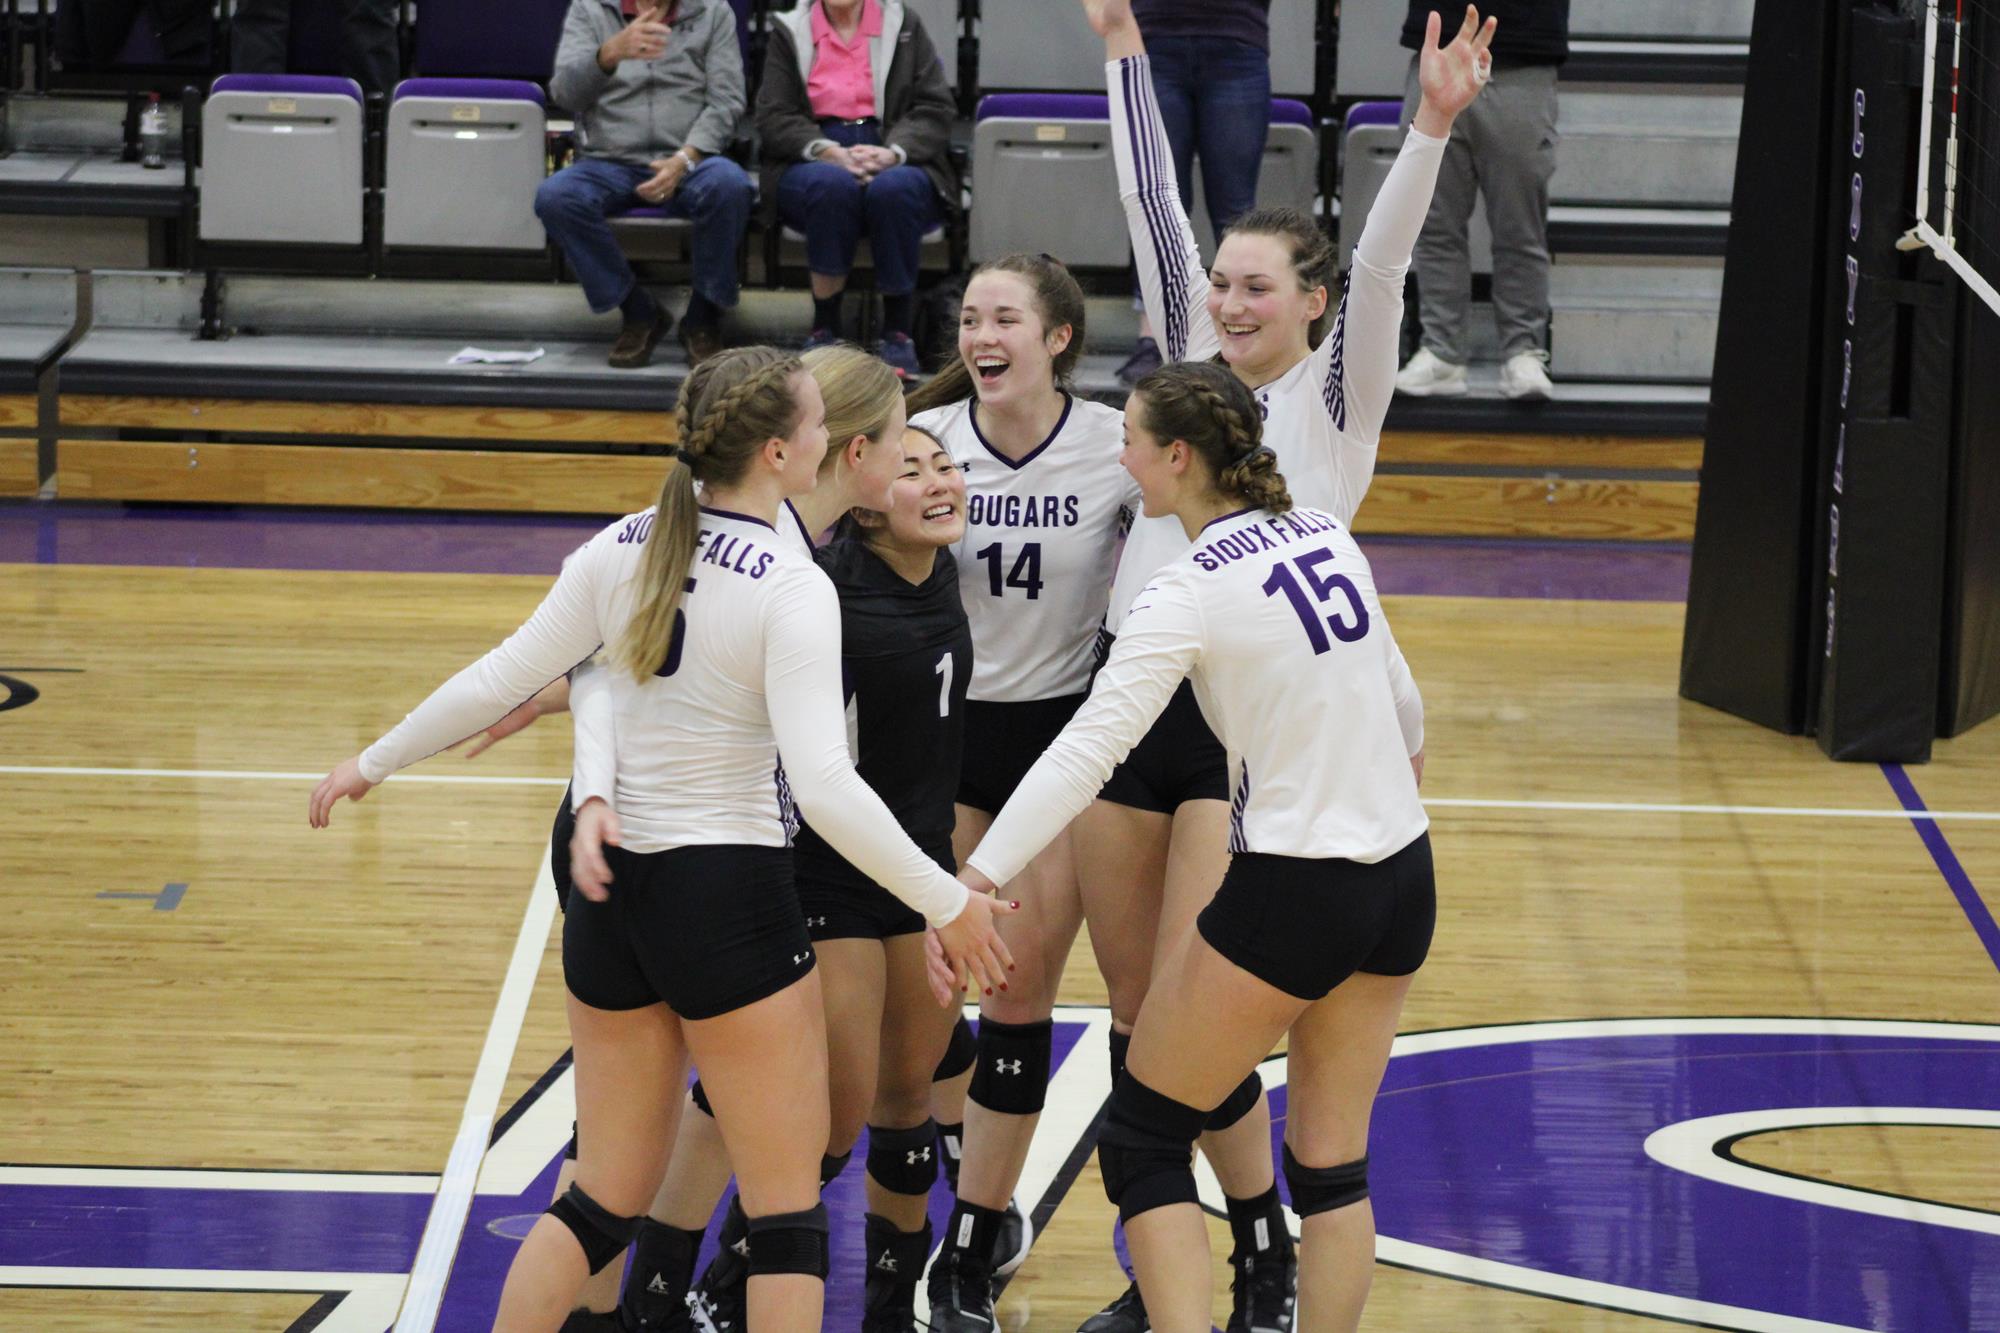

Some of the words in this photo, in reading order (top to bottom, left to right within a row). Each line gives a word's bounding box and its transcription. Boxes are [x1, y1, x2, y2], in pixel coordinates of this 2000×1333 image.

[968, 494, 1079, 528] OUGARS
[1192, 523, 1279, 572] SIOUX
[1265, 511, 1337, 544] FALLS
[976, 542, 1044, 600] 14
[1261, 546, 1370, 656] 15
[935, 652, 954, 718] 1
